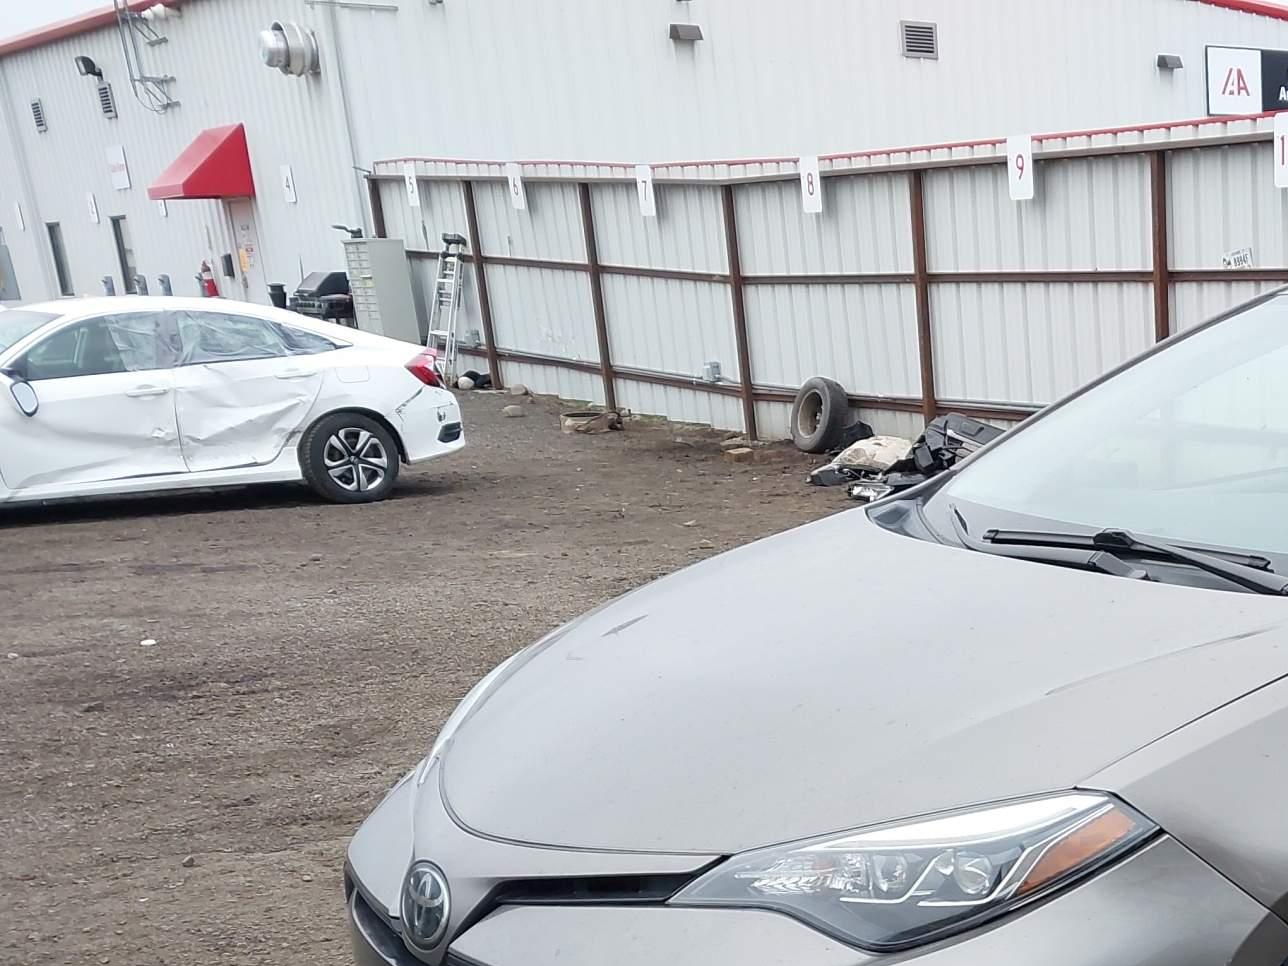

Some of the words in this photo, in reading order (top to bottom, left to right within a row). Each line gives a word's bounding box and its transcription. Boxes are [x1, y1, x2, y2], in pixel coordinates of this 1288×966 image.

[1015, 154, 1025, 181] 9
[408, 178, 415, 194] 5
[512, 179, 520, 196] 6
[640, 180, 648, 201] 7
[805, 172, 815, 197] 8
